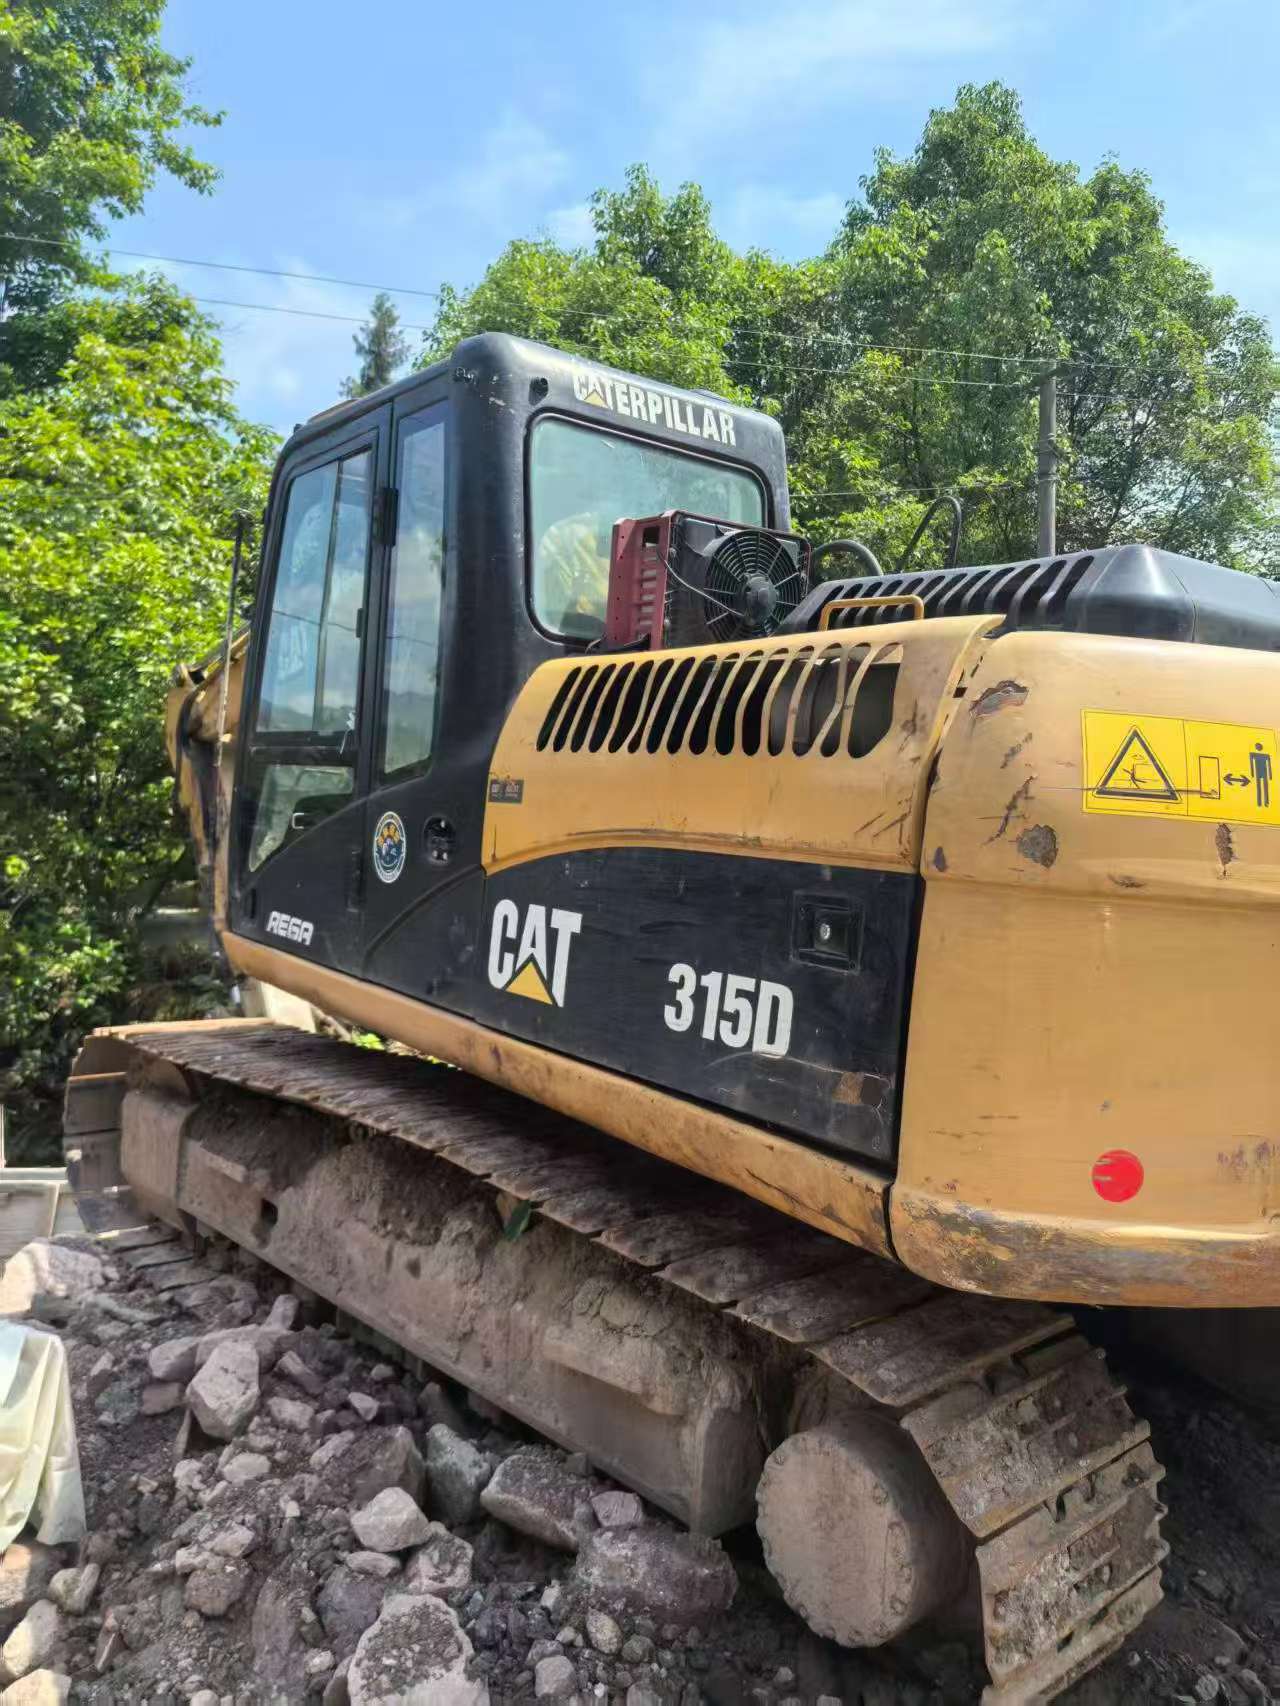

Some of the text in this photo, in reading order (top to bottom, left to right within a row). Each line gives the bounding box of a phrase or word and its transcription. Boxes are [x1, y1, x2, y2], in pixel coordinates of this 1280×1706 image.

[573, 375, 737, 447] CATERPILLAR
[488, 899, 583, 1008] CAT
[663, 963, 794, 1057] 315D
